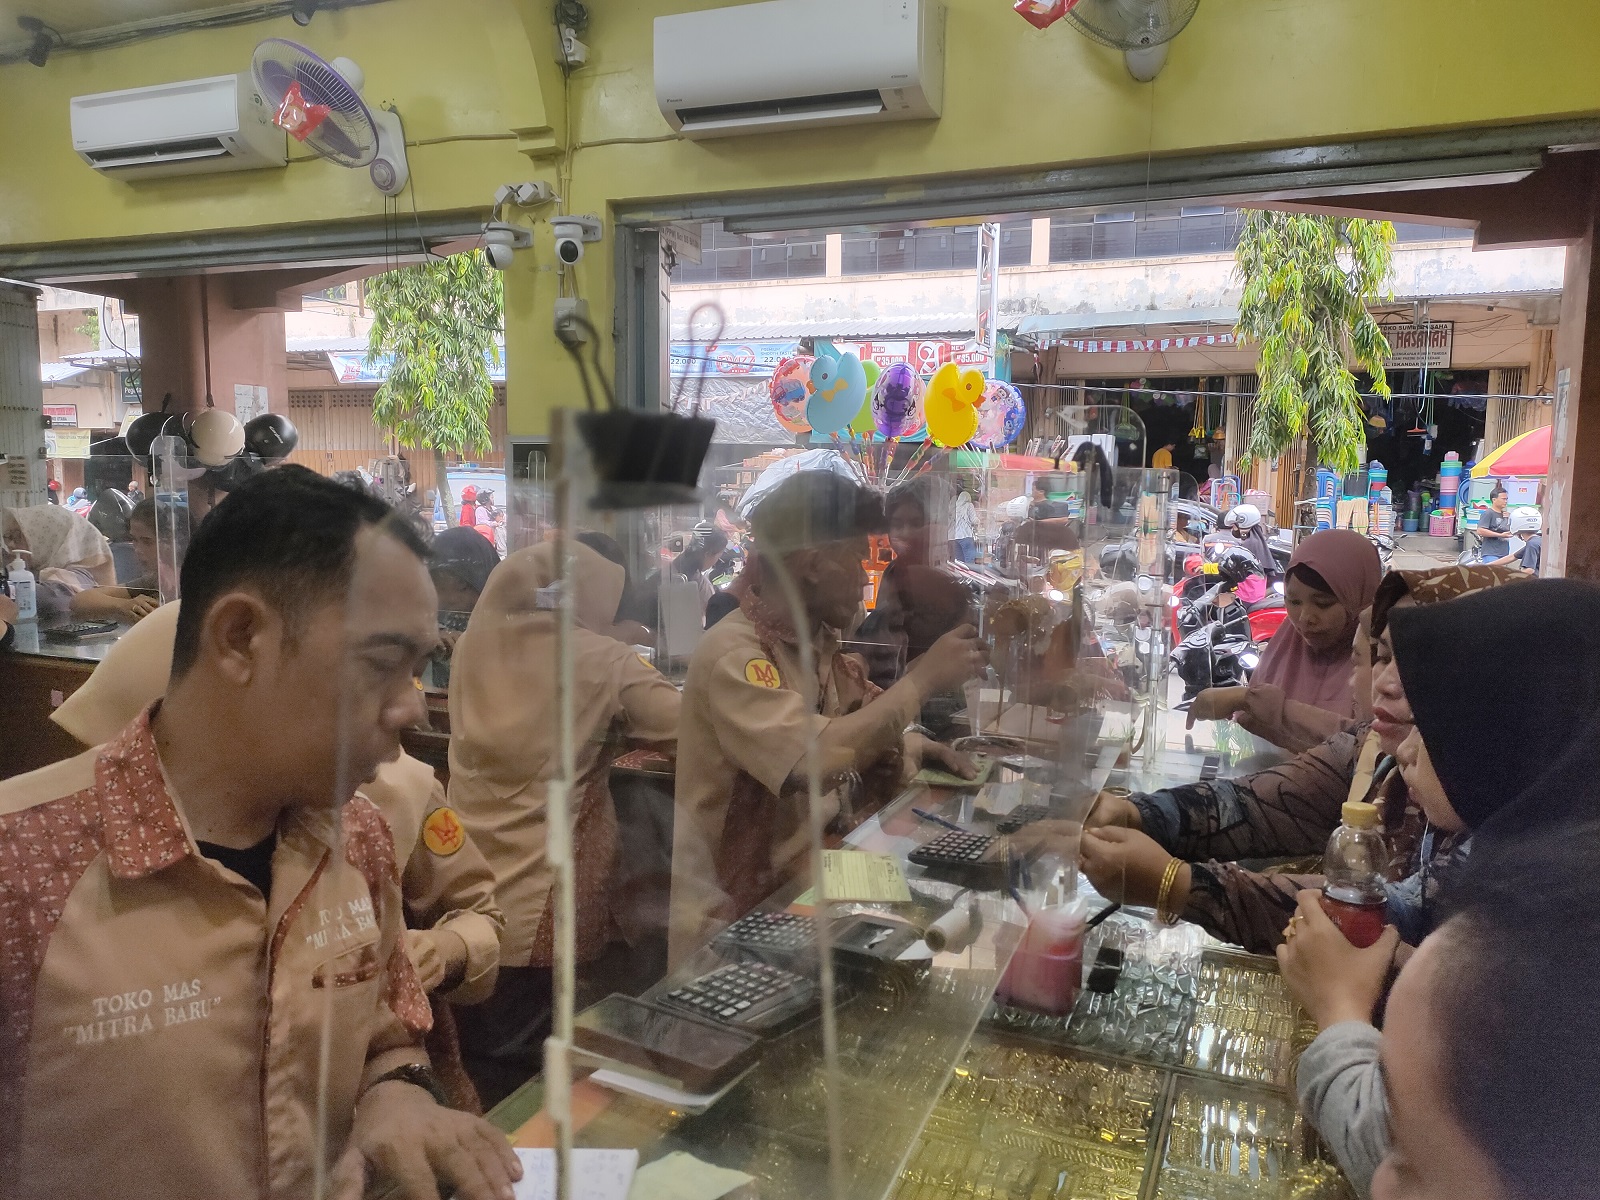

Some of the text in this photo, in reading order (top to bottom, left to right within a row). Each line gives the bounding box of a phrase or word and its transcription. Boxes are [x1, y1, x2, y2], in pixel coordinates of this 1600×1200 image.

[1395, 330, 1448, 349] HASANAH
[92, 978, 202, 1017] TOKO MAS
